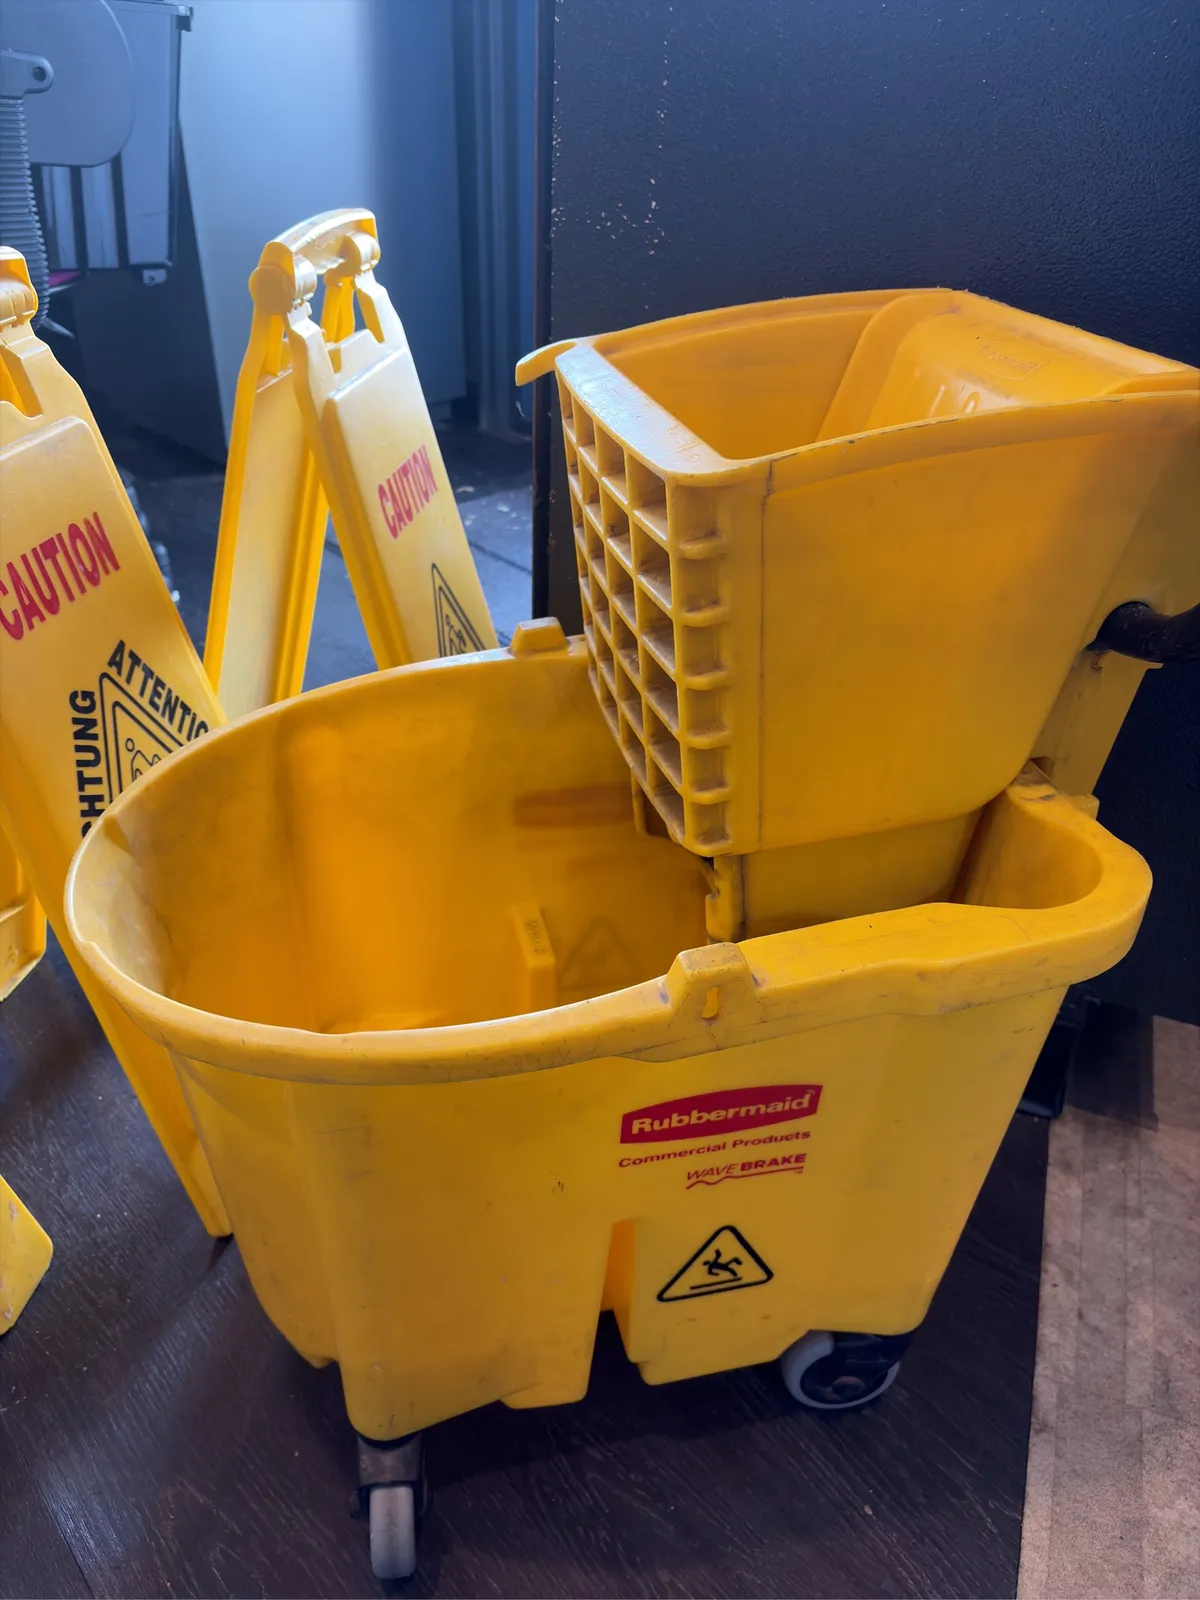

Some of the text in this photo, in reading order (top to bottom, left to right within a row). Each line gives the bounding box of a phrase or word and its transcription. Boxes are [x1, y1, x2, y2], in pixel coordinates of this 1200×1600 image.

[376, 443, 439, 540] CAUTION
[0, 511, 121, 640] CAUTION
[69, 689, 106, 839] HTUNG
[618, 1129, 812, 1168] Commercial Products
[631, 1092, 811, 1135] Rubbermaid
